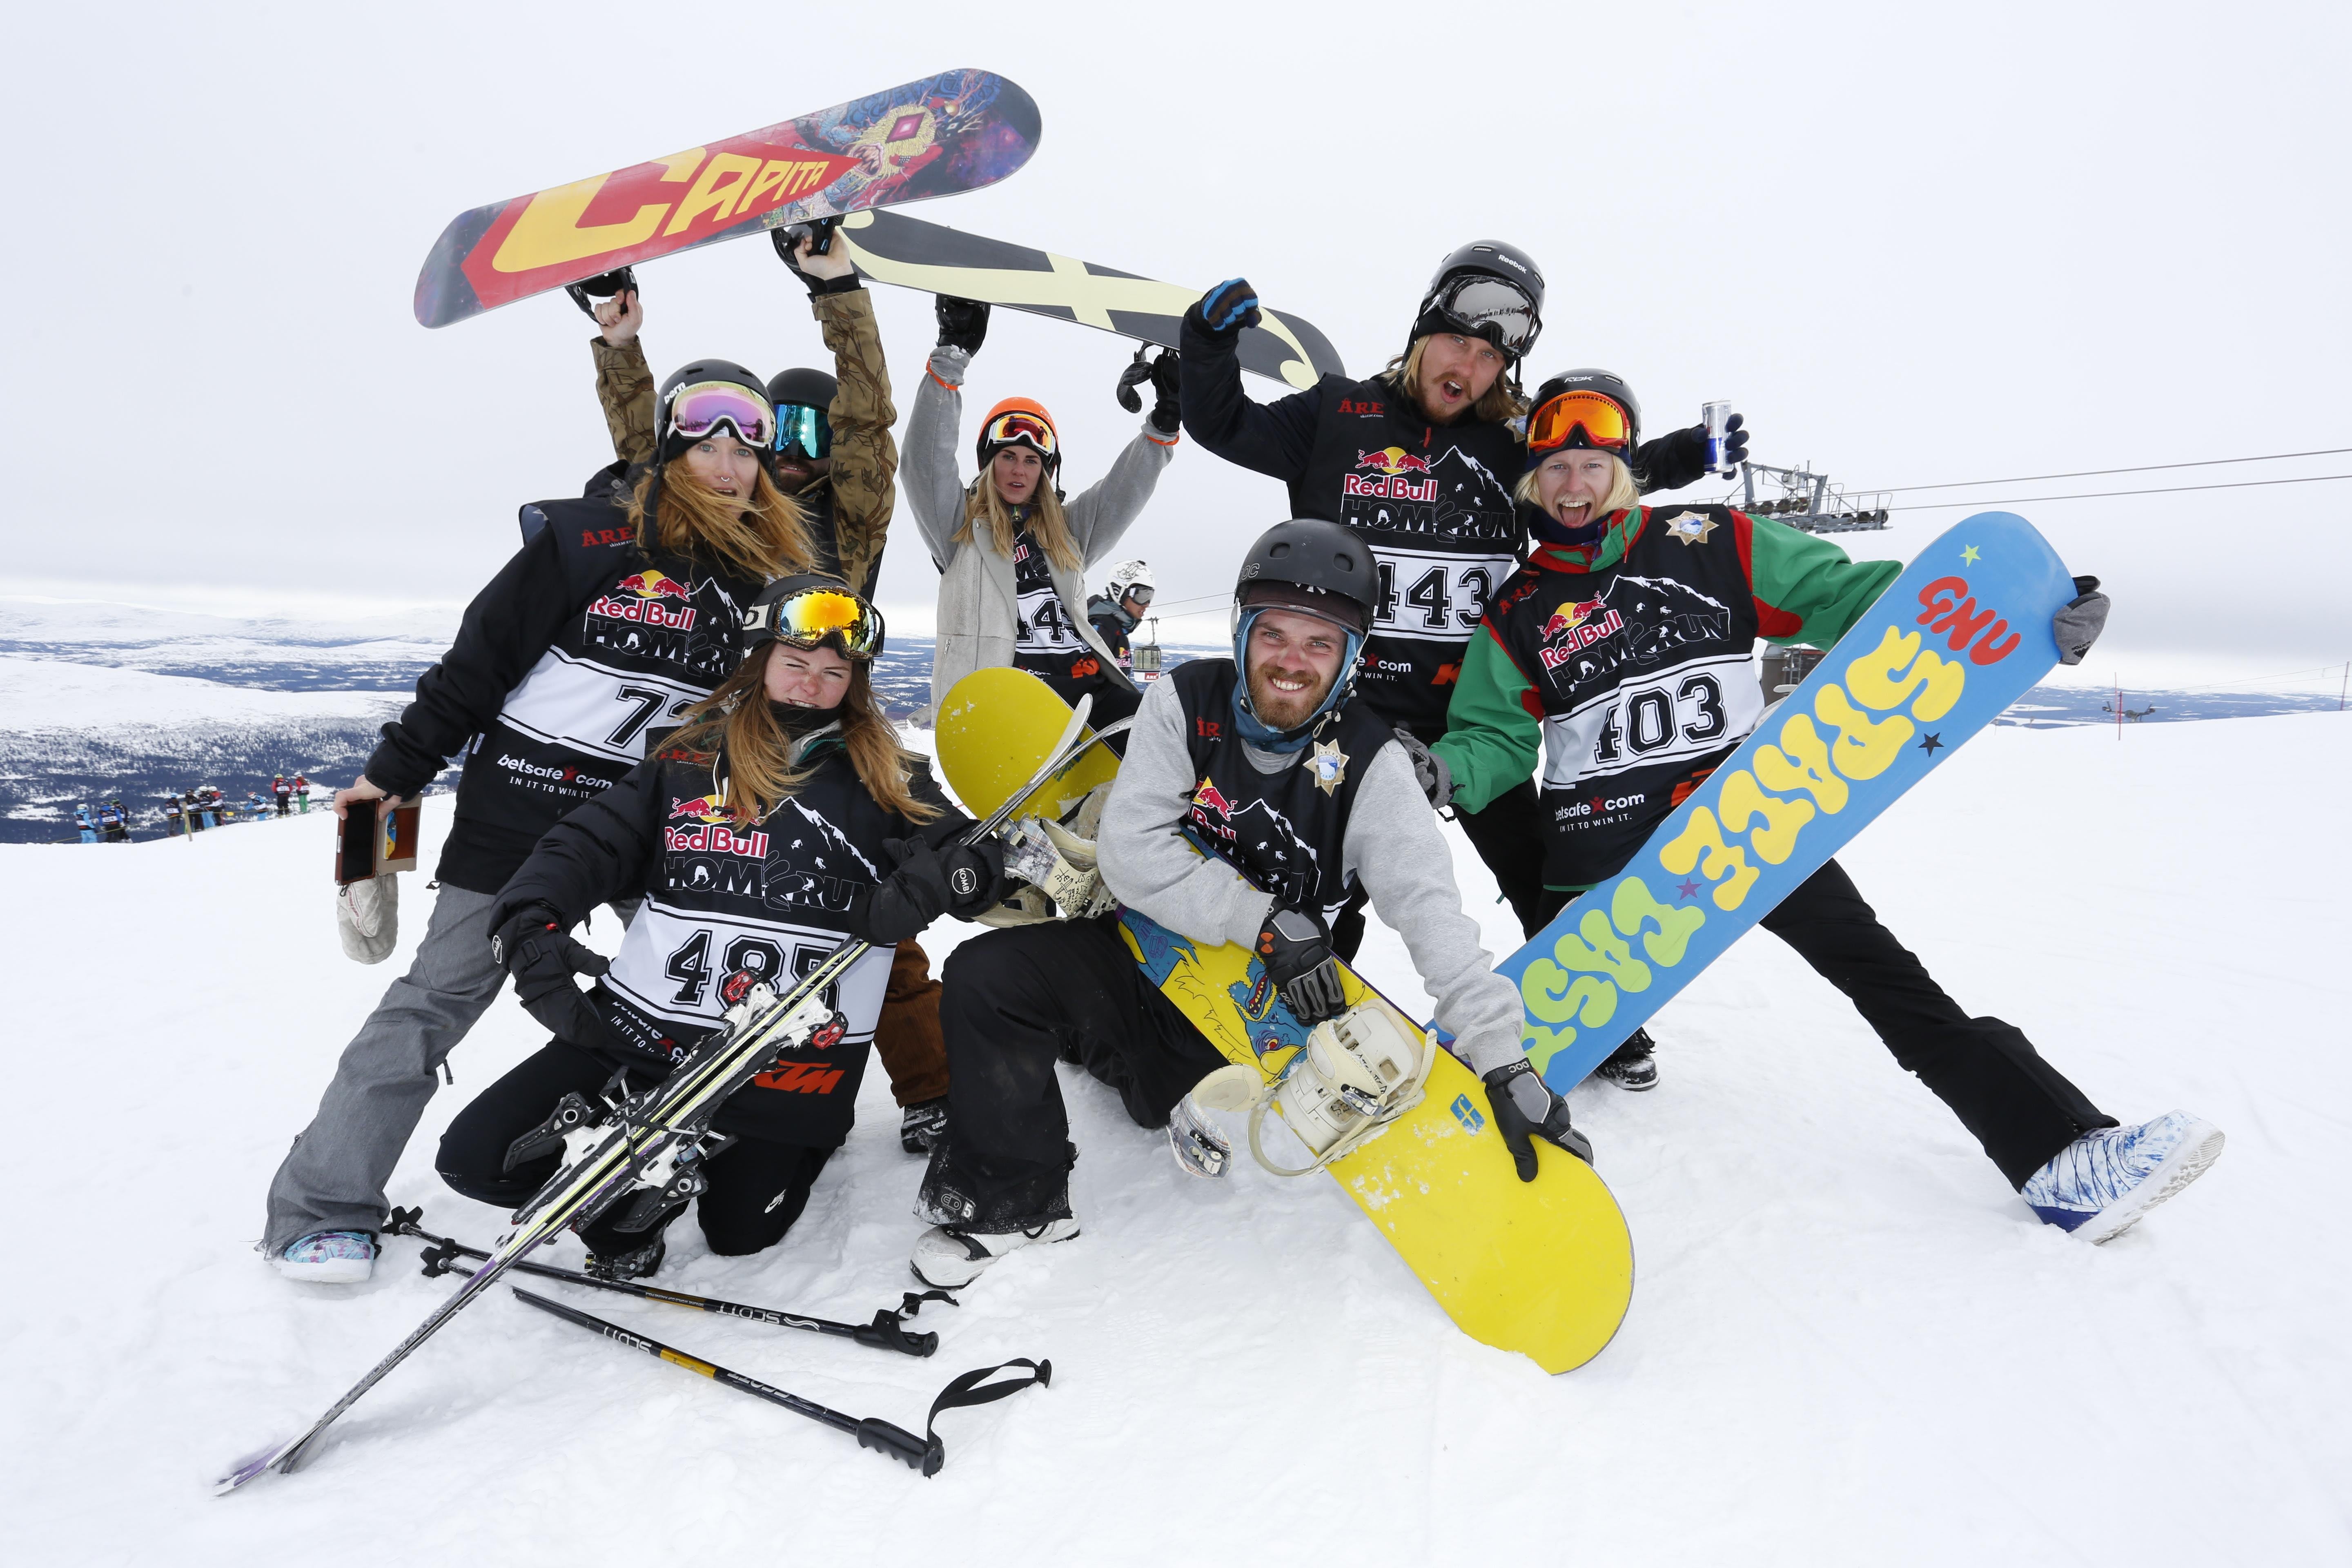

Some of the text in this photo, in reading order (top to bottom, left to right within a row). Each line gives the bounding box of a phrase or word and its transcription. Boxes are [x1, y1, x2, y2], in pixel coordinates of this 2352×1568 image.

[492, 145, 830, 272] CAPITA
[1498, 254, 1527, 274] Reebok
[664, 382, 686, 405] bern
[1918, 576, 2021, 666] GNU
[1594, 672, 1729, 763] 403
[1660, 625, 1965, 911] SPACE
[510, 776, 522, 785] IN
[526, 780, 539, 789] IT
[543, 784, 555, 793] TO
[559, 787, 577, 797] WIN
[1577, 821, 1589, 830] TO
[1592, 816, 1614, 827] WIN
[610, 1016, 646, 1048] IN IT TO
[753, 1060, 846, 1094] KTM
[715, 1303, 781, 1325] SCOTT
